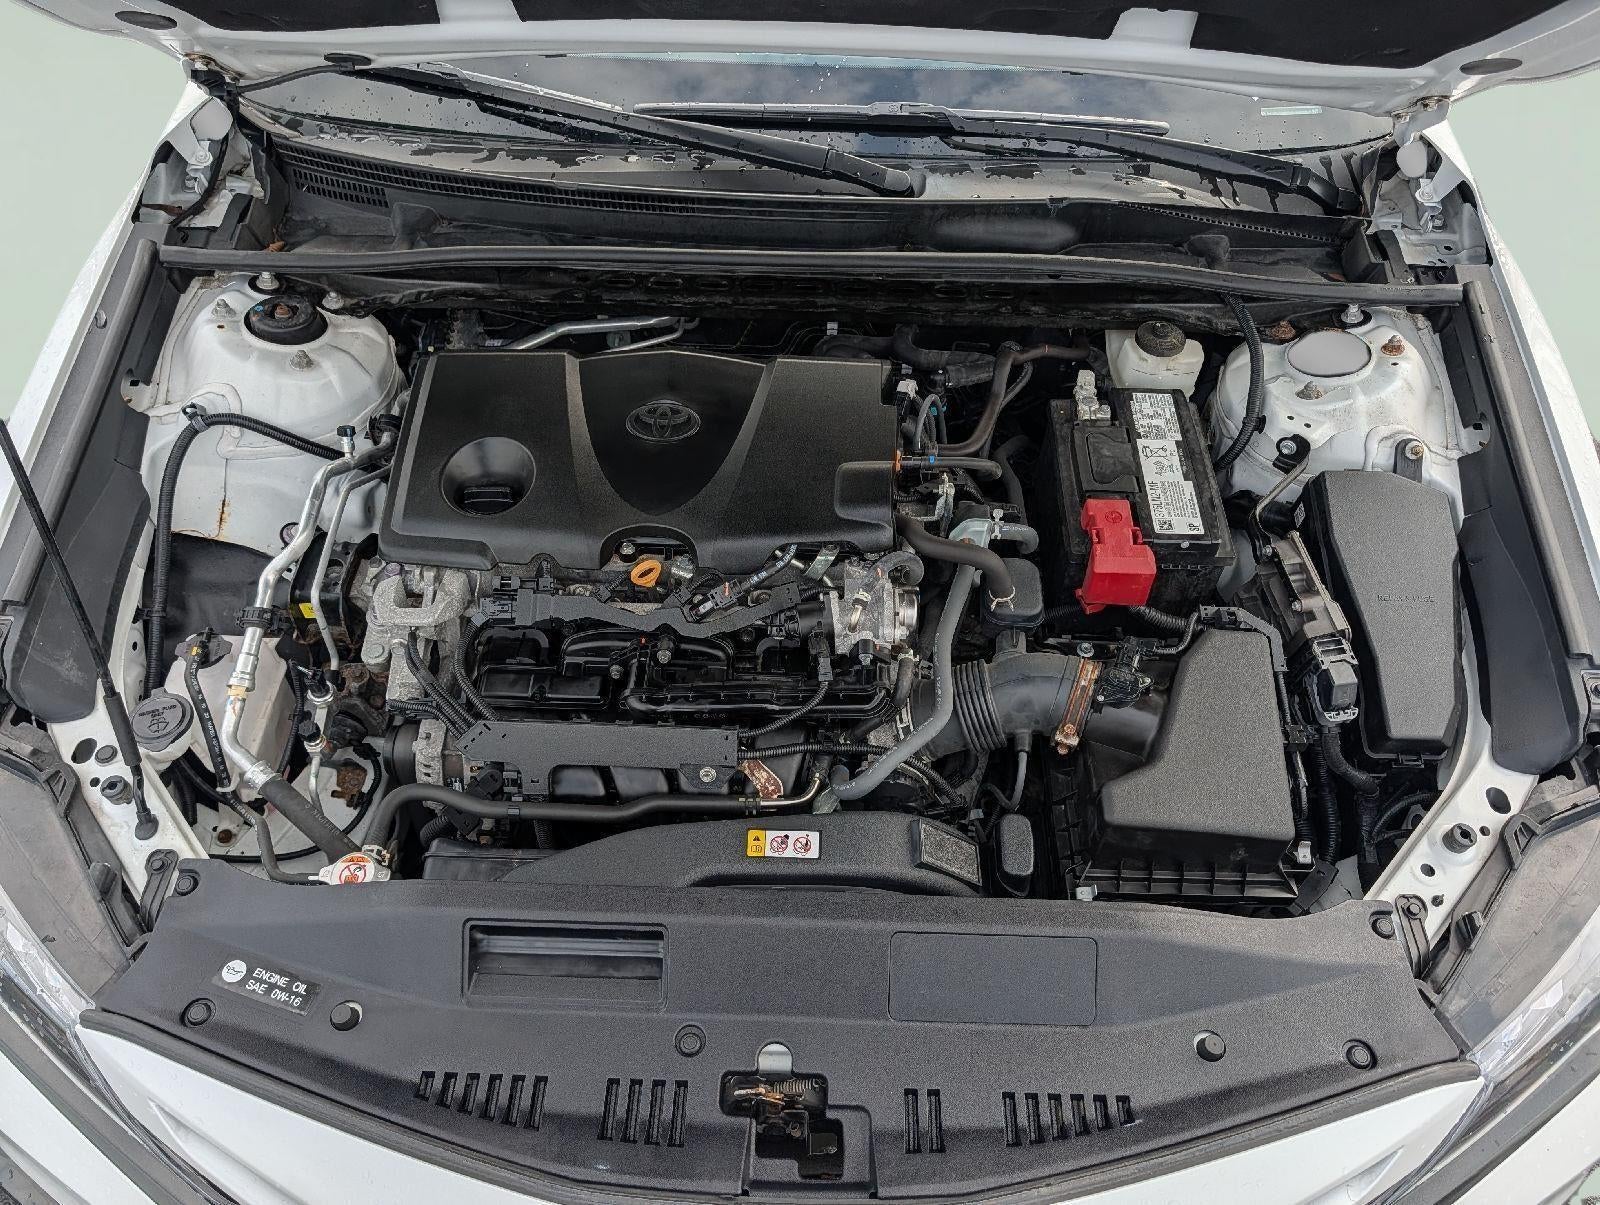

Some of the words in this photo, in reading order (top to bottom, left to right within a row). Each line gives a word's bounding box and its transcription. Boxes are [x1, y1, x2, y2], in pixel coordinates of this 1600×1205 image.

[245, 979, 269, 994] SAE
[270, 988, 303, 1007] 0W-16
[252, 967, 291, 988] ENGINE
[292, 981, 308, 995] OIL
